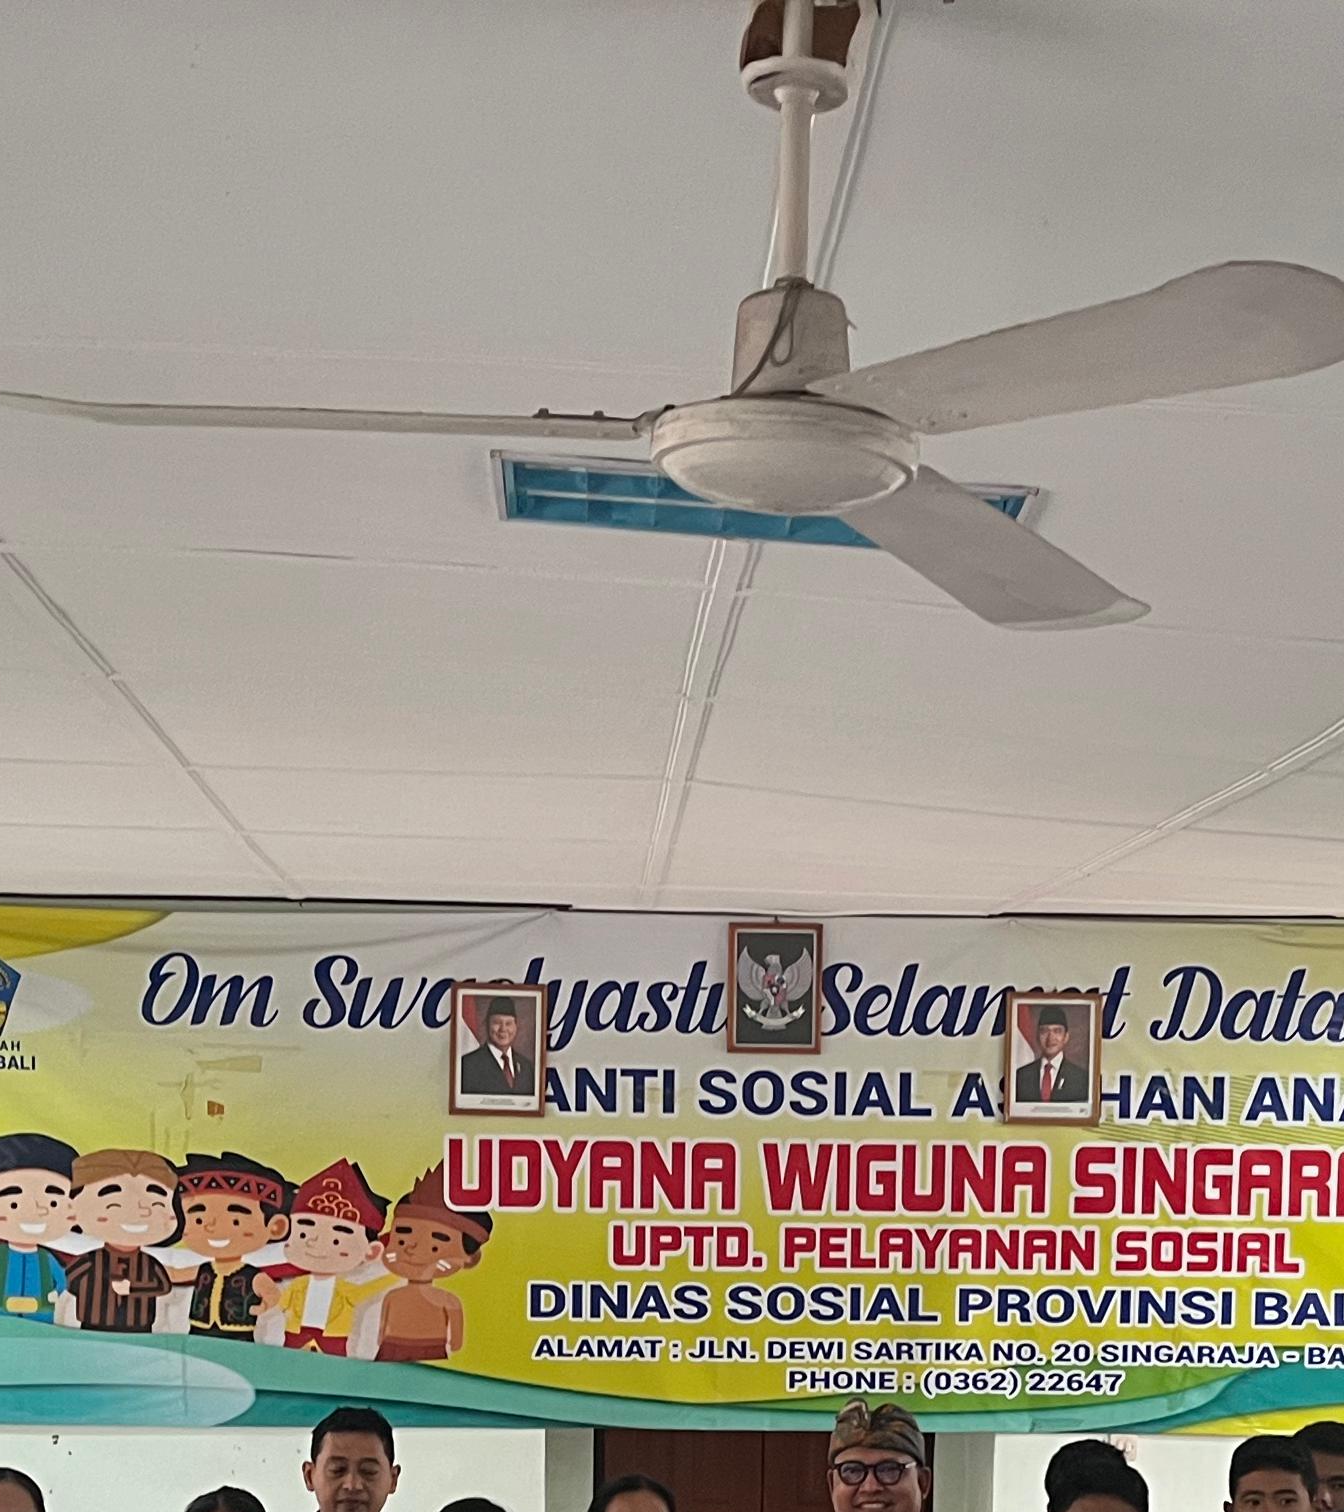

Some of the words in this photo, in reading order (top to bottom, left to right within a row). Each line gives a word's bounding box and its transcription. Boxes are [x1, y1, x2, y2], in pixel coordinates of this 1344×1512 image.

[141, 951, 279, 1028] Om
[544, 1067, 676, 1114] ANTI
[698, 1069, 932, 1118] SOSIAL
[951, 1072, 1226, 1121] AHAN
[448, 1138, 737, 1210] UDYANA
[763, 1142, 1047, 1215] WIGUNA
[611, 1224, 764, 1267] UPTD.
[783, 1227, 1095, 1272] PELAYANAN
[1115, 1230, 1300, 1274] SOSIAL
[528, 1282, 708, 1320] DINAS
[727, 1285, 940, 1323] SOSIAL
[957, 1288, 1231, 1325] PROVINSI
[534, 1337, 663, 1359] ALAMAT
[688, 1339, 757, 1361] JLN.
[767, 1340, 844, 1361] DEWI
[854, 1341, 982, 1362] SARTIKA
[993, 1342, 1044, 1363] NO.
[1055, 1343, 1091, 1363] 20
[1100, 1344, 1275, 1366] SINGARAJA
[788, 1370, 897, 1391] PHONE
[922, 1371, 1019, 1396] (0362)
[1028, 1372, 1125, 1393] 22647
